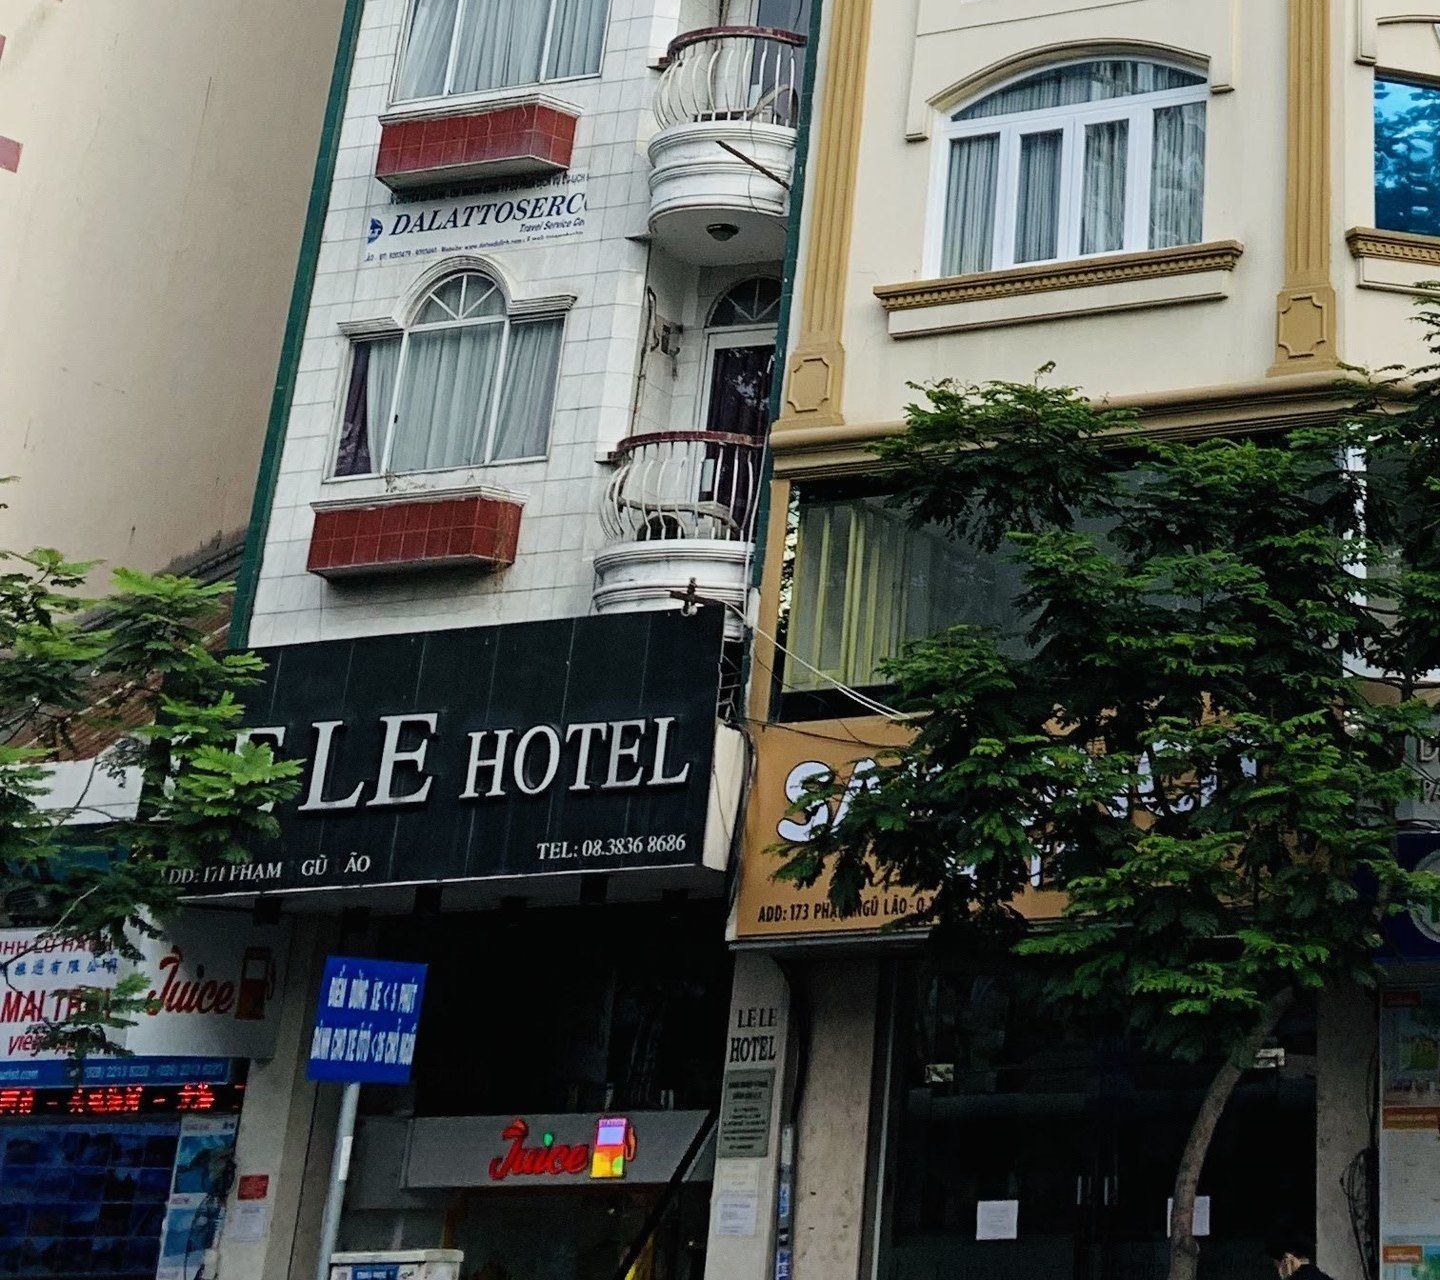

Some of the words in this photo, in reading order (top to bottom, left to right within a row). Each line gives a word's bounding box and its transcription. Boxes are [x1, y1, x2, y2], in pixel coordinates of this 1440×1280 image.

[298, 713, 438, 811] LE
[458, 716, 691, 800] HOTEL
[537, 842, 580, 860] TEL:
[582, 836, 645, 858] 08.3836
[646, 833, 687, 854] 8686
[758, 905, 787, 922] ADD:
[790, 903, 810, 921] 173
[147, 945, 233, 1016] Juice
[730, 1034, 777, 1063] HOTEL
[488, 1117, 591, 1181] Juice
